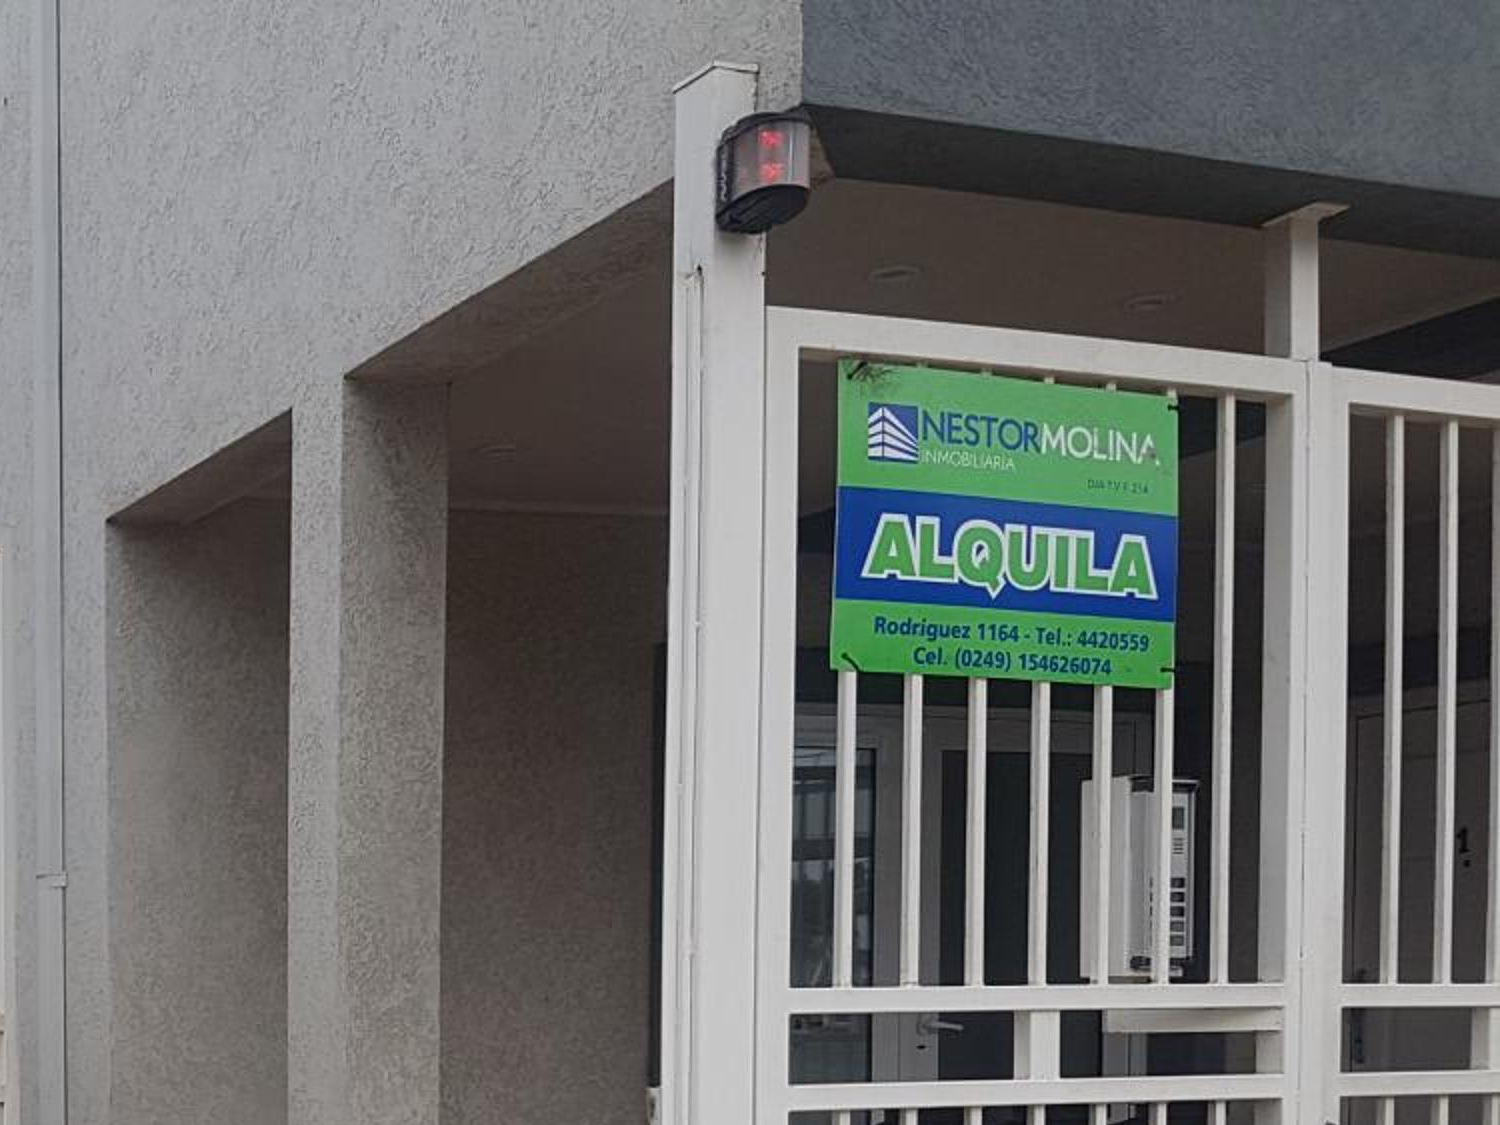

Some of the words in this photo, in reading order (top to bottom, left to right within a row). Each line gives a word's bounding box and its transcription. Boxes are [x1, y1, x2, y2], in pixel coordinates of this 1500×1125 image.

[921, 450, 1016, 472] INMOBILIARIA
[861, 512, 1158, 599] ALQUILA
[977, 623, 1019, 643] 1164
[1077, 630, 1150, 651] 4420559
[913, 646, 947, 665] Cel.
[955, 648, 1011, 671] (0249)
[1018, 652, 1112, 675] 154626074
